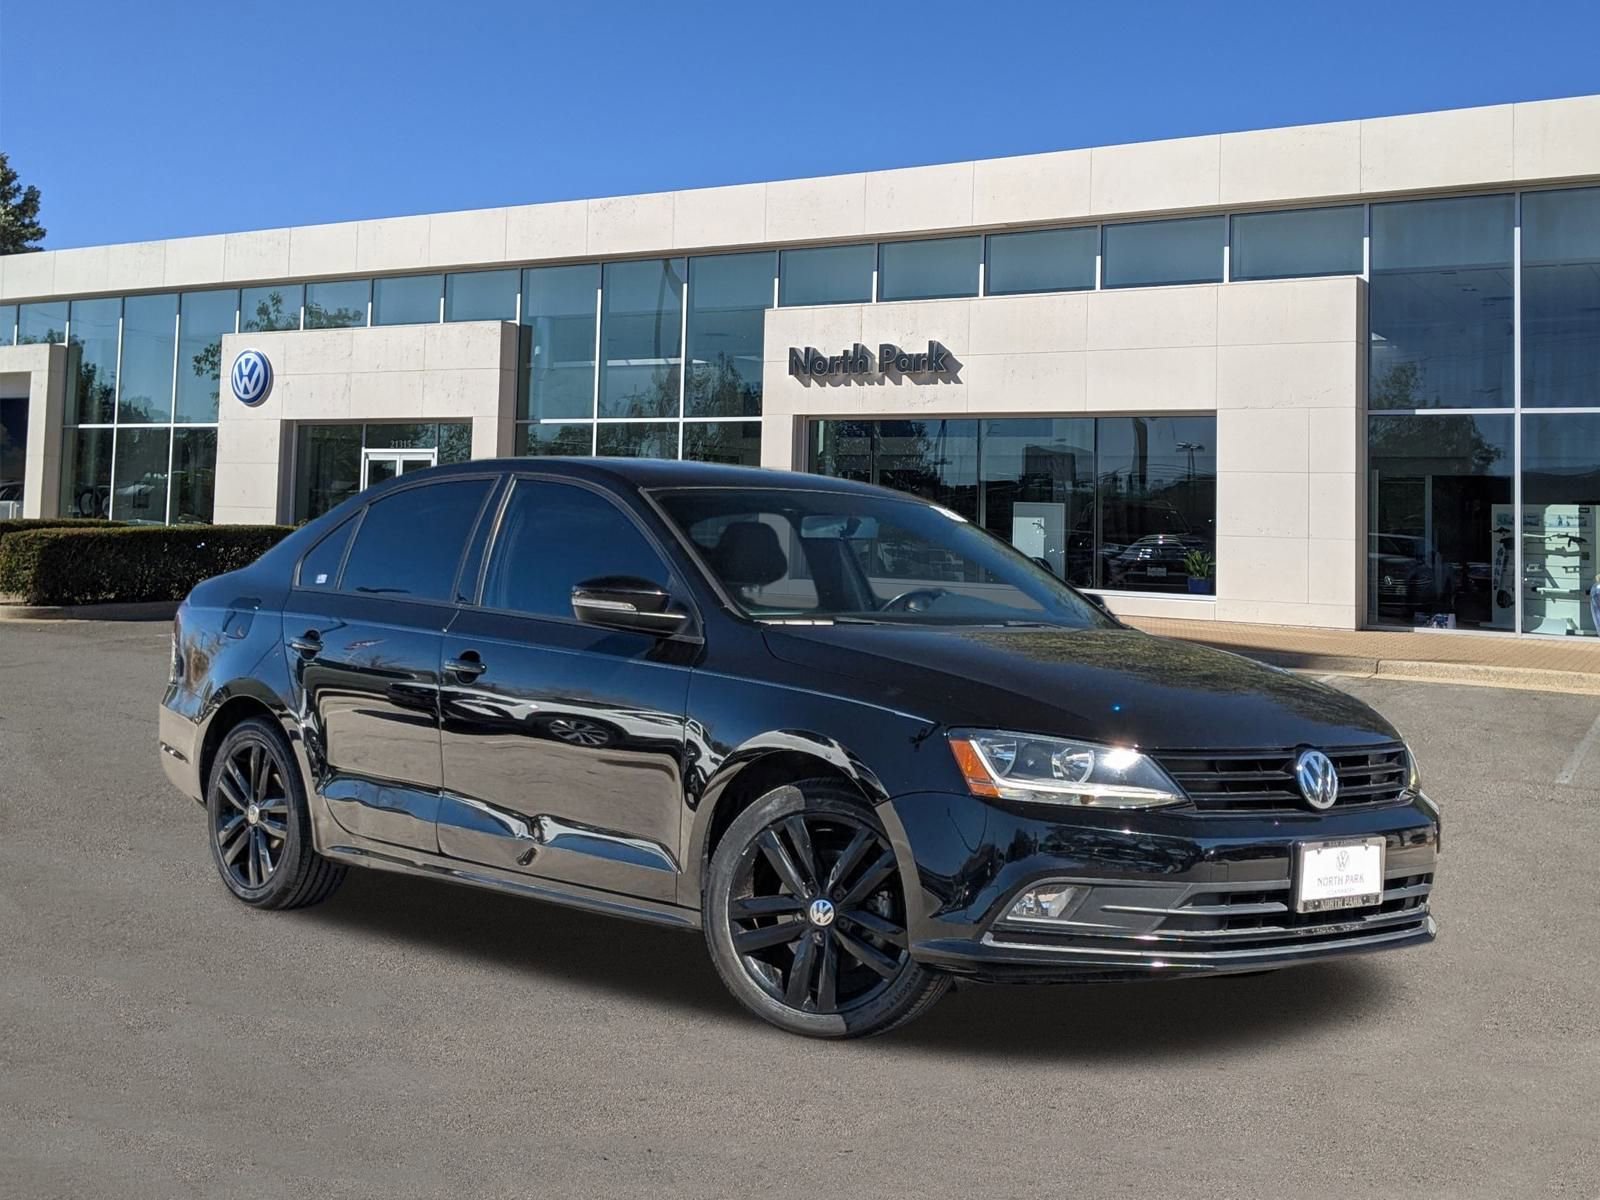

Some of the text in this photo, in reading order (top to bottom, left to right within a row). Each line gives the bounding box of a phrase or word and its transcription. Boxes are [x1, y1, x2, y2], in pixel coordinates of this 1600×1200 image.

[233, 353, 267, 399] VW
[788, 340, 949, 376] North Park
[1299, 752, 1337, 808] VW
[1317, 873, 1365, 888] NORTH PARK
[811, 900, 834, 926] VW
